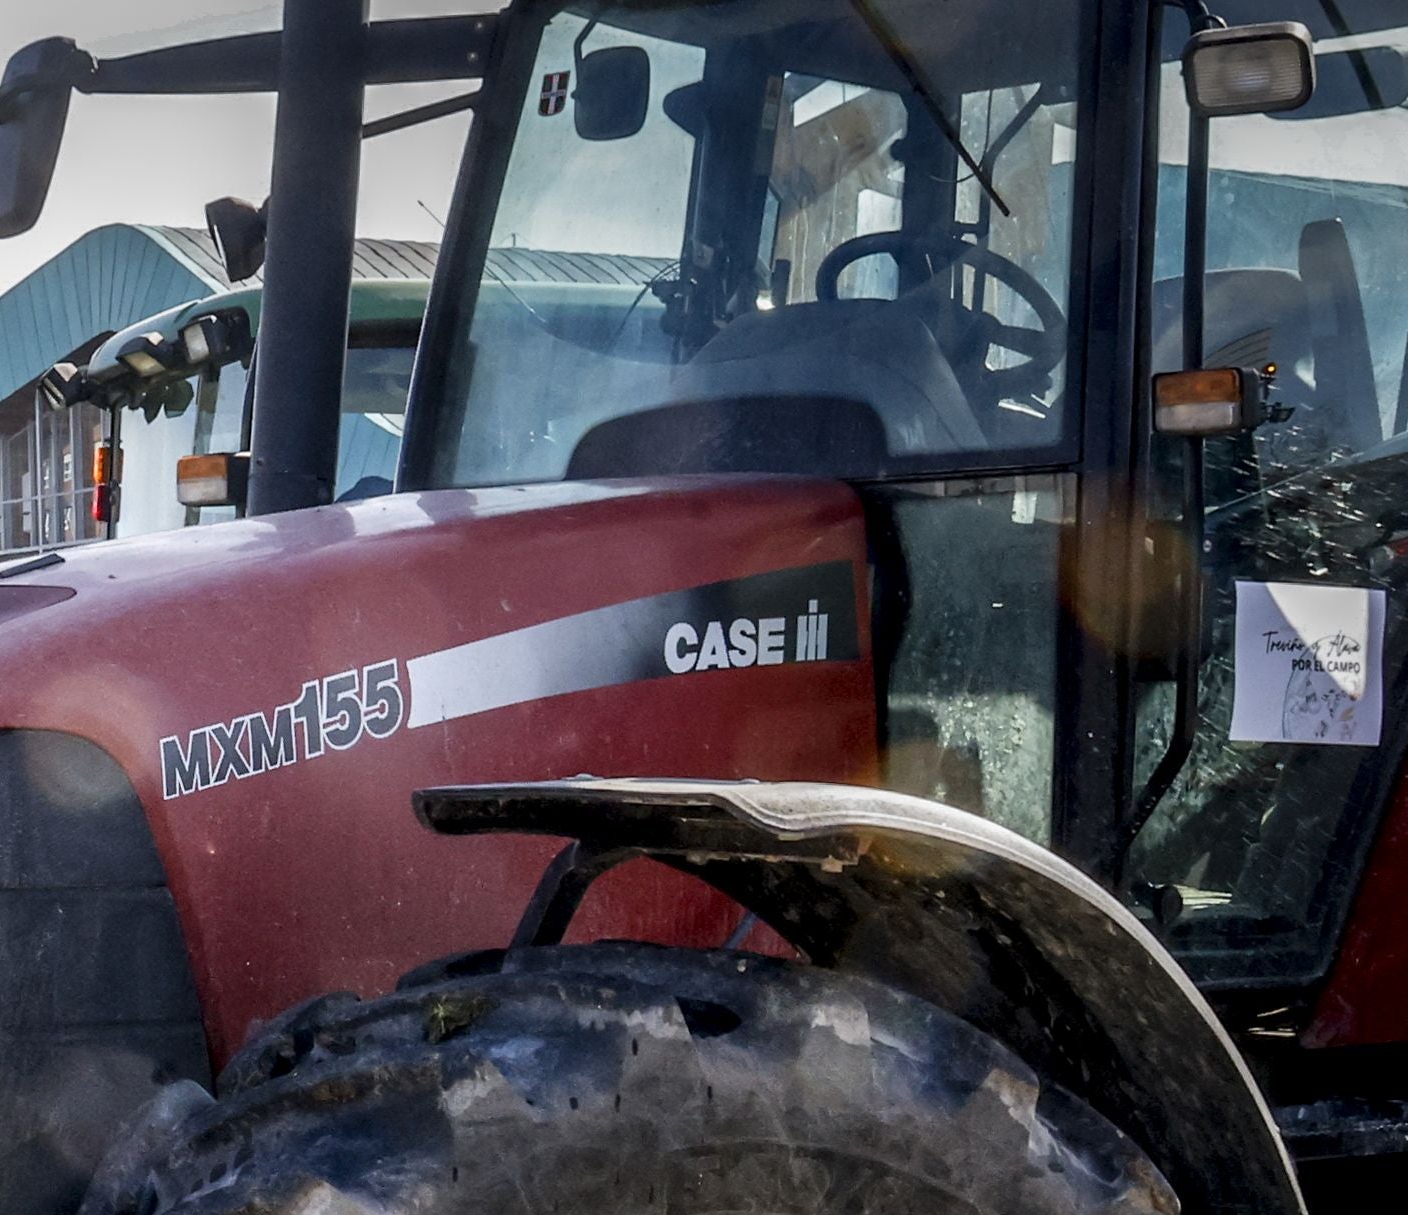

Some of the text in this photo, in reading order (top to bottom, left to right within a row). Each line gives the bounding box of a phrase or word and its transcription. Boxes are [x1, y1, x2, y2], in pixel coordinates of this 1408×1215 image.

[664, 617, 785, 674] CASE
[1291, 658, 1361, 674] POR EL CAMPO
[160, 658, 403, 800] MXM155
